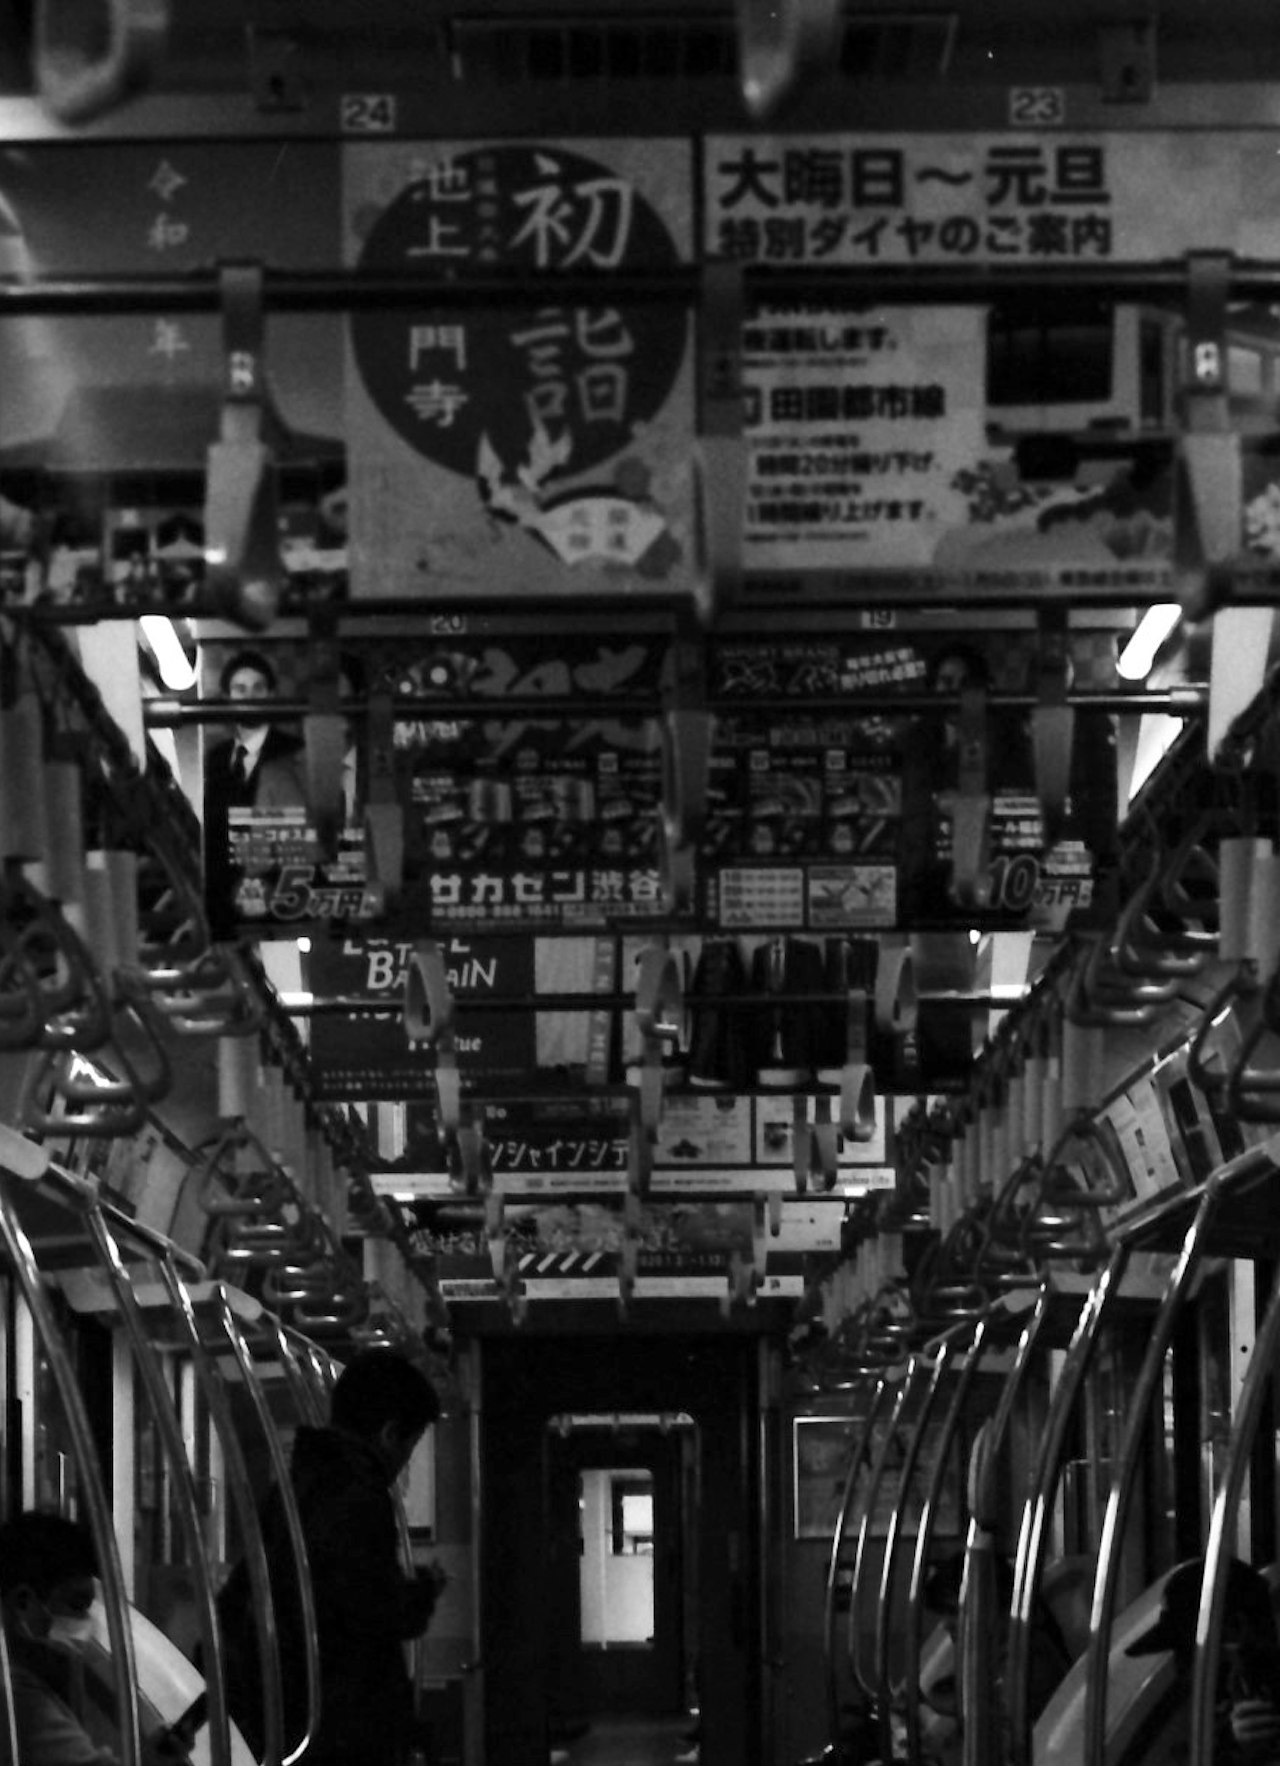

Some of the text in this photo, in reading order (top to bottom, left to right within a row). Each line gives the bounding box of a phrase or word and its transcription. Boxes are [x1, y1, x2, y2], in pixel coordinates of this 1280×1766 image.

[347, 98, 390, 129] 24
[1014, 90, 1060, 121] 23
[719, 214, 1113, 258] 特別ダイヤのご案内
[146, 160, 190, 358] 令和年
[404, 159, 471, 429] 池上門寺
[509, 152, 635, 430] 初詣
[366, 949, 498, 989] BAAIN
